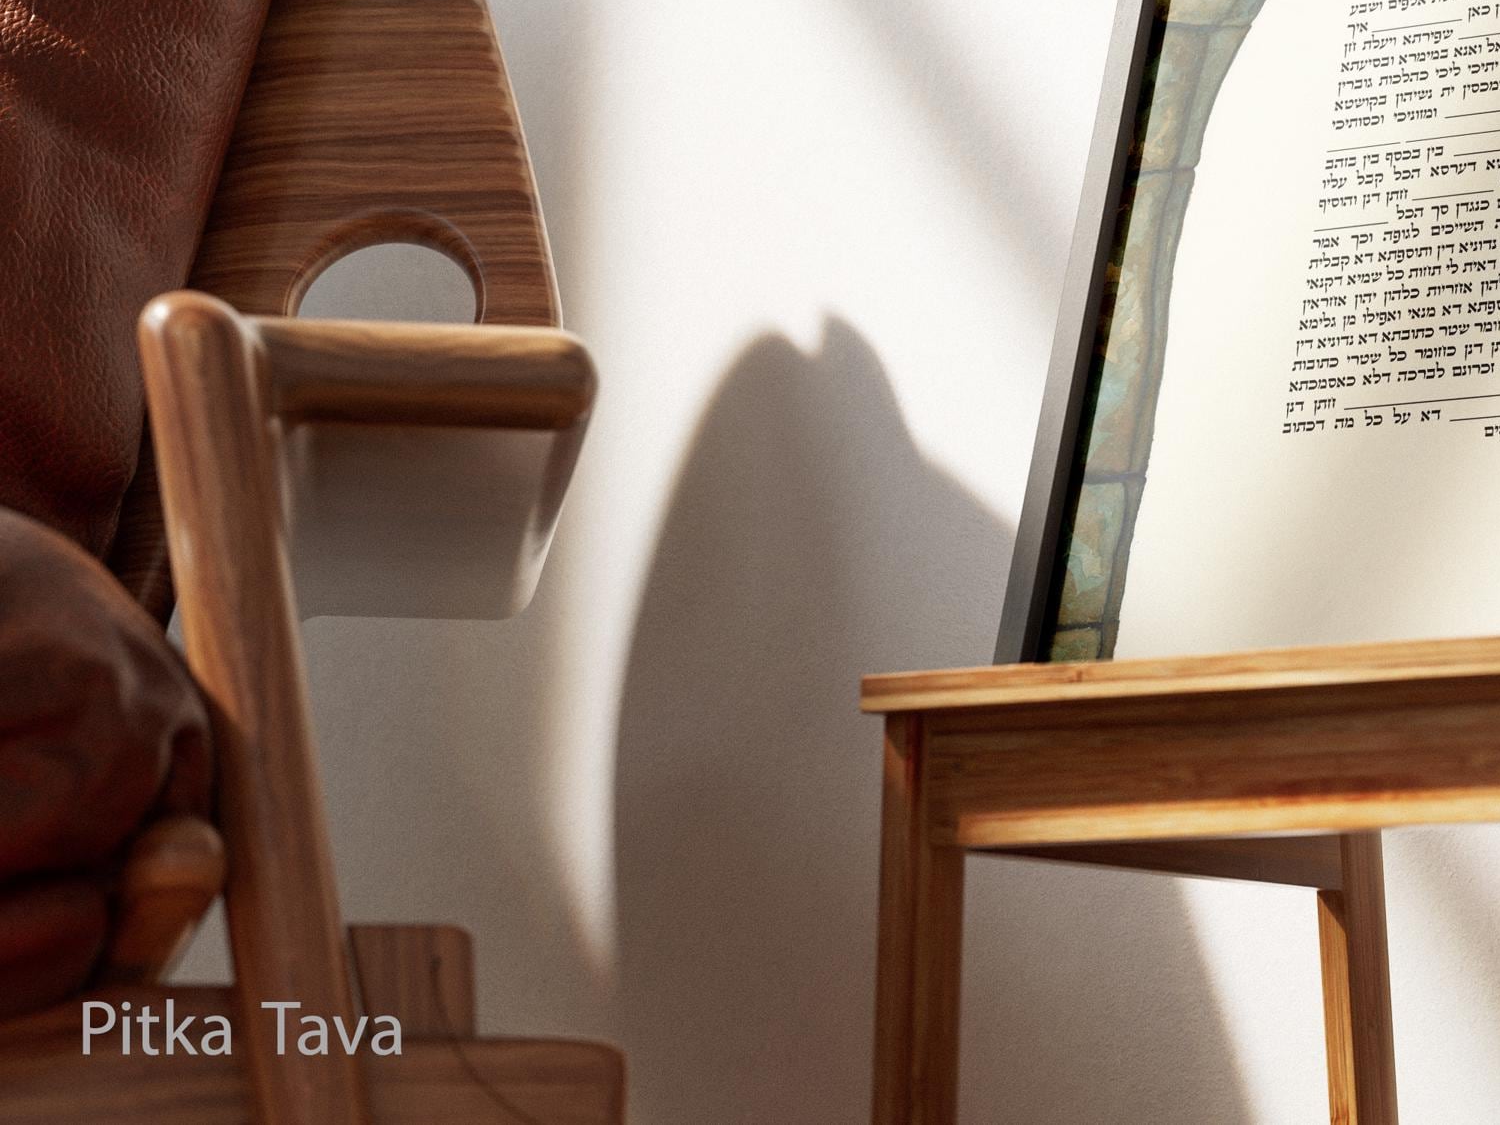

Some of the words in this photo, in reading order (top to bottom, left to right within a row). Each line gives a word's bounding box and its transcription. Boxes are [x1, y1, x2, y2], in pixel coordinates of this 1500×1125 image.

[1349, 0, 1383, 17] ושבע
[1467, 4, 1491, 23] כאן
[1347, 21, 1369, 40] איך
[1398, 48, 1449, 66] במימרא
[1453, 43, 1483, 58] ואנא
[1340, 55, 1395, 73] ובסיעתא
[1395, 88, 1433, 109] נשיהון
[1440, 85, 1456, 98] ית
[1334, 94, 1388, 112] בקושטא
[1331, 114, 1385, 131] וכסותיכי
[1392, 107, 1438, 123] ומזוניכי
[1392, 164, 1421, 182] הכל
[1429, 161, 1478, 178] דערסא
[1321, 172, 1348, 190] עליו
[1355, 169, 1384, 189] קבל
[1395, 203, 1425, 221] הכל
[1430, 204, 1450, 222] סך
[1455, 199, 1491, 220] כנגדן
[1377, 245, 1433, 264] ותוספתא
[1436, 243, 1456, 262] דין
[1458, 238, 1498, 254] נדוניא
[1308, 251, 1351, 272] קבלית
[1353, 252, 1374, 266] דא
[1383, 282, 1421, 308] כלהון
[1425, 281, 1473, 298] אחריות
[1302, 295, 1348, 316] אחראין
[1354, 291, 1377, 311] יהון
[1357, 332, 1379, 346] דא
[1380, 327, 1435, 344] כתובתא
[1438, 323, 1471, 337] שטר
[1296, 338, 1314, 357] דין
[1316, 334, 1355, 350] נדוניא
[1362, 367, 1392, 386] דלא
[1396, 360, 1446, 383] לברכה
[1451, 362, 1496, 378] זכרונם
[1288, 375, 1357, 393] כאסמכתא
[1333, 417, 1355, 430] מה
[1363, 409, 1384, 427] כל
[1392, 406, 1412, 426] על
[1420, 409, 1442, 423] דא
[1281, 419, 1326, 434] דכתוב
